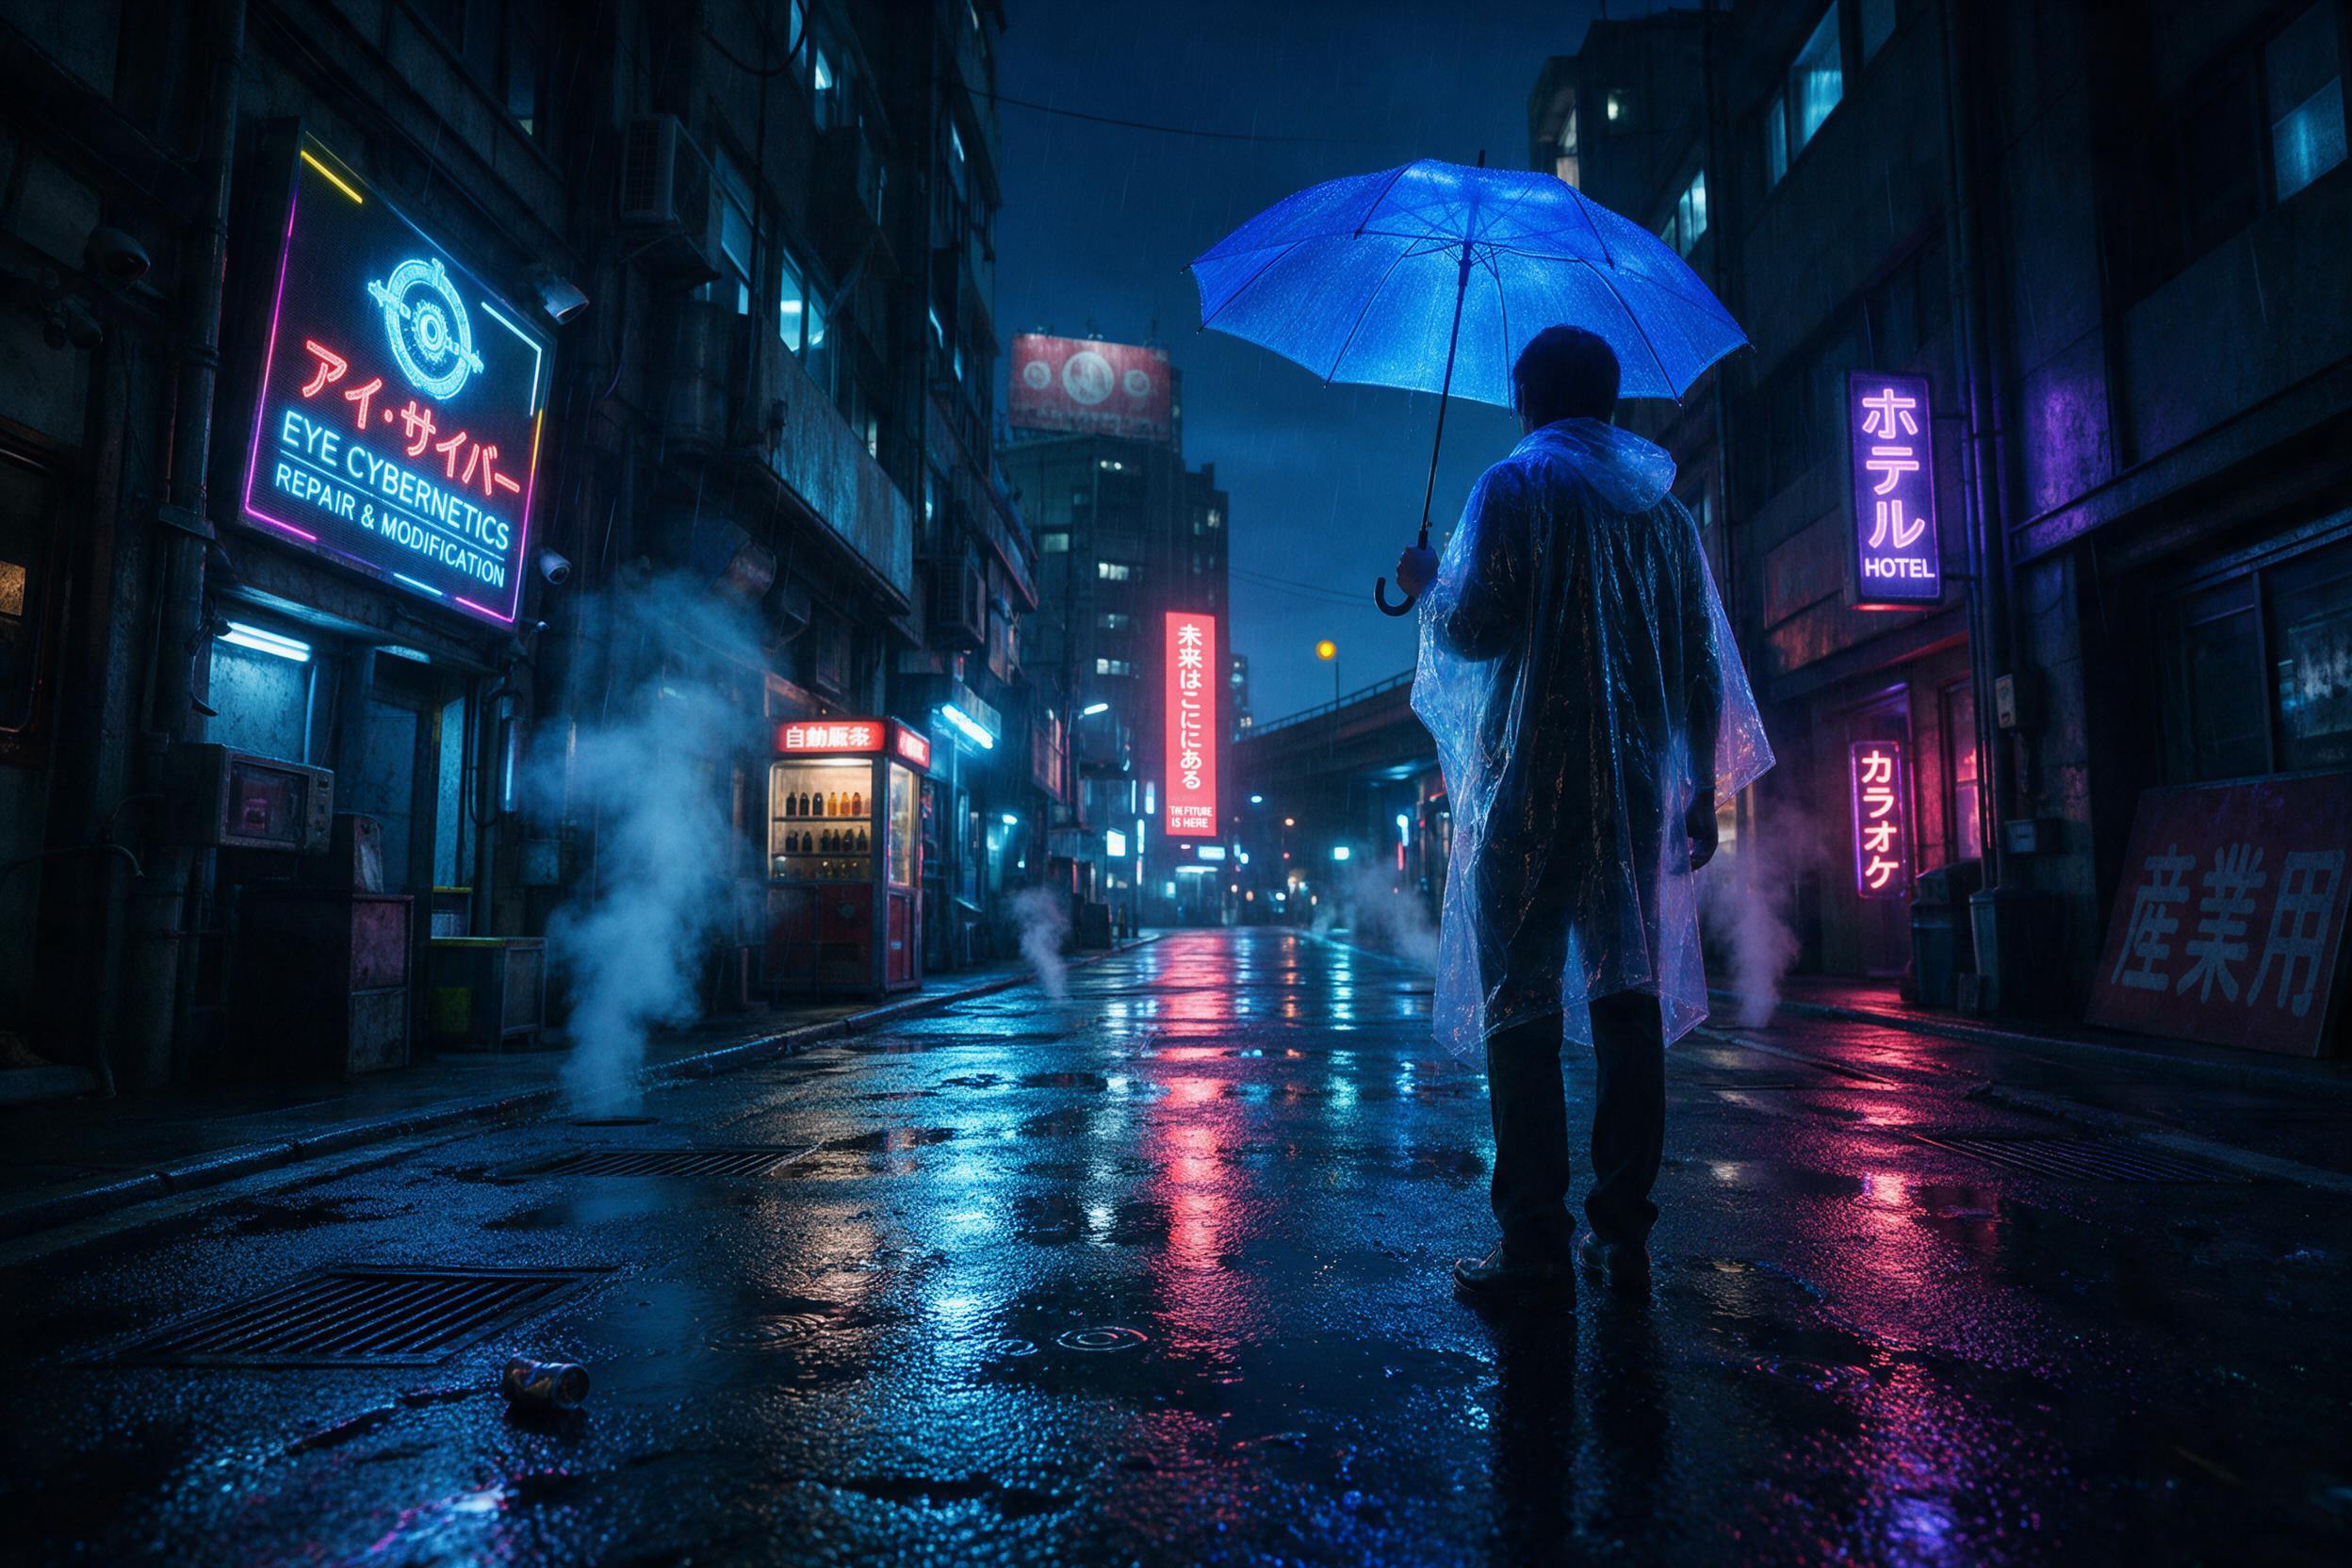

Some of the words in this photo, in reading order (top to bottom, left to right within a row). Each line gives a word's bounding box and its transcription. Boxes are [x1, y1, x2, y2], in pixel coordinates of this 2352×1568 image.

[283, 408, 341, 467] EYE
[347, 445, 510, 551] CYBERNETICS
[302, 340, 520, 496] アイ・サイバー
[1861, 388, 1926, 549] ホテル
[275, 462, 357, 521] REPAIR
[360, 503, 375, 531] &
[380, 512, 506, 589] MODIFICATION
[1864, 557, 1936, 580] HOTEL
[1177, 623, 1203, 791] 未来はこににある
[1171, 817, 1181, 829] IS
[1183, 817, 1209, 829] HERE
[1861, 750, 1900, 889] カラオケ
[2110, 842, 2346, 1019] 産業用
